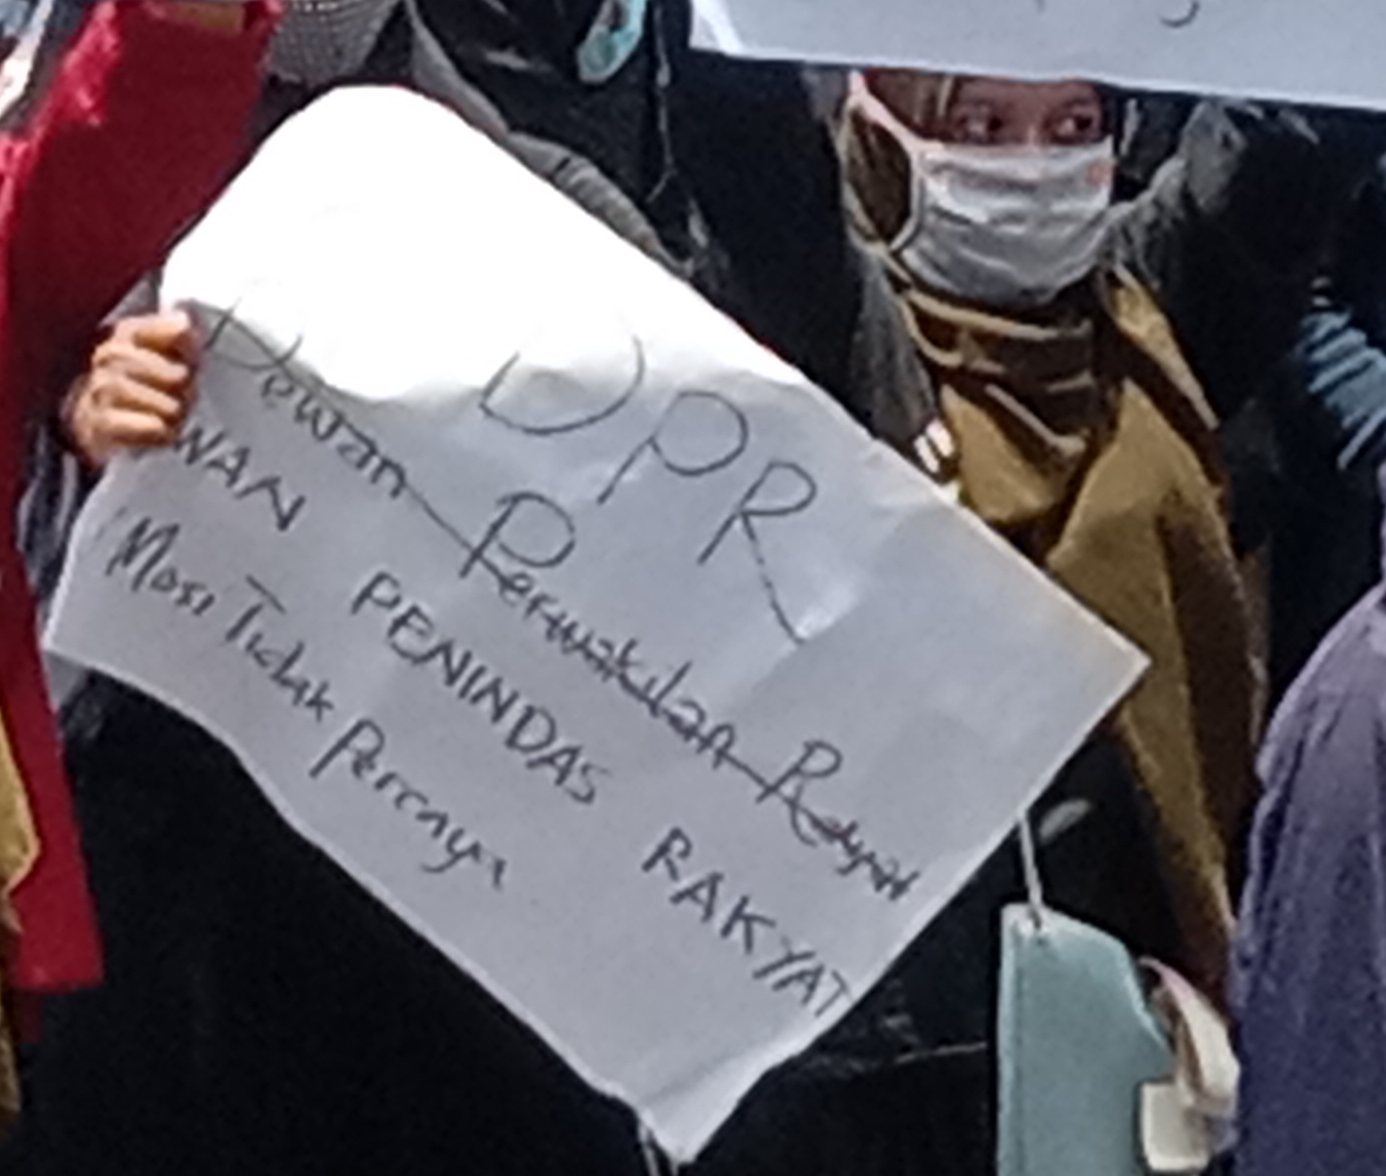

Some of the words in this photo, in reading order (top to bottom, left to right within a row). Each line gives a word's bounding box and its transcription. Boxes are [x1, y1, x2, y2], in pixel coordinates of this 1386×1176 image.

[203, 298, 411, 502] Dewan
[478, 332, 817, 645] DPR
[105, 516, 217, 618] Mosi
[350, 569, 609, 807] PENINDAS
[640, 825, 851, 1020] RAKYAT
